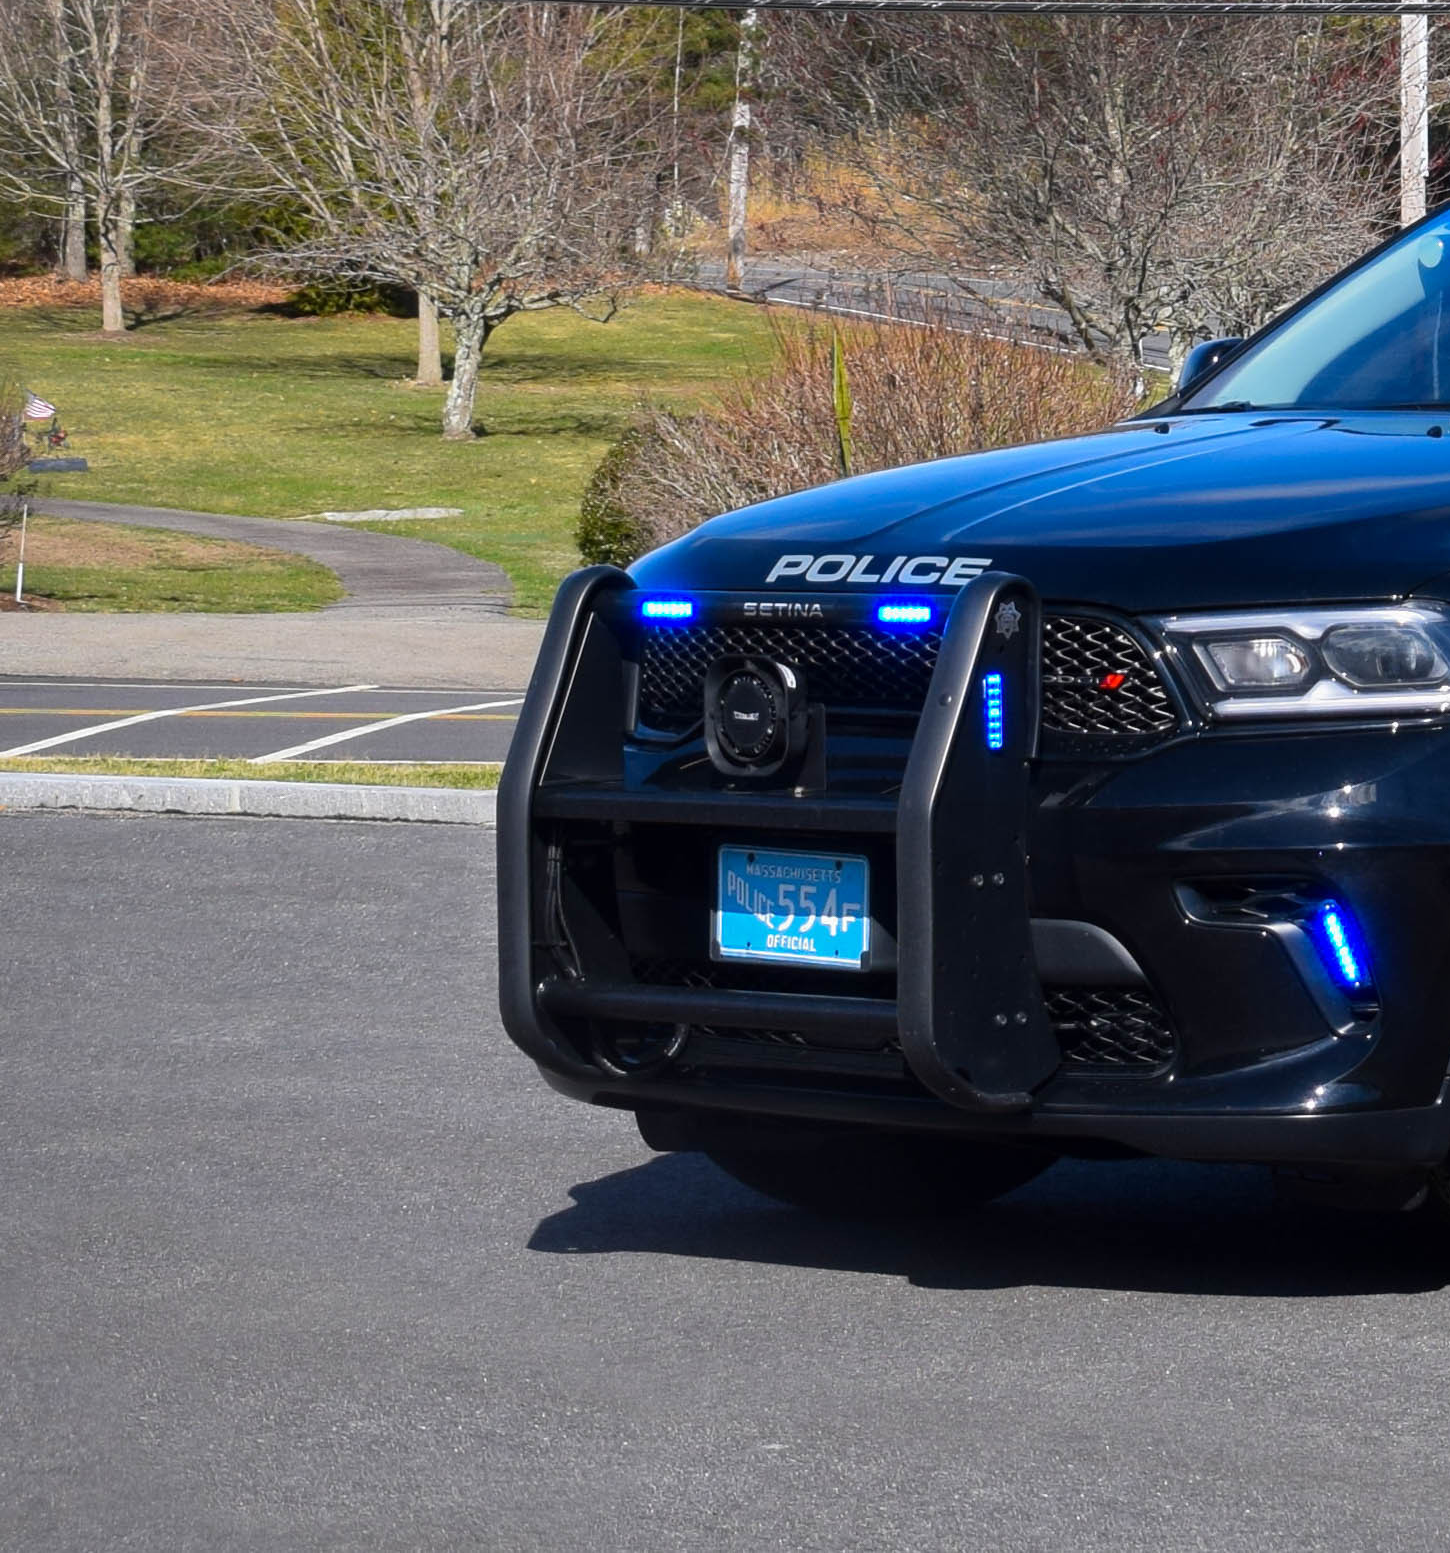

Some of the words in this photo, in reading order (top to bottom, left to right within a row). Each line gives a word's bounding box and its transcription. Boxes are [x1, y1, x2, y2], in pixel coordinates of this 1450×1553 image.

[765, 554, 993, 586] POLICE
[743, 601, 824, 619] SETINA
[746, 862, 842, 885] MASSACHUSETTS
[727, 869, 776, 930] POLICE
[766, 933, 817, 953] OFFICIAL
